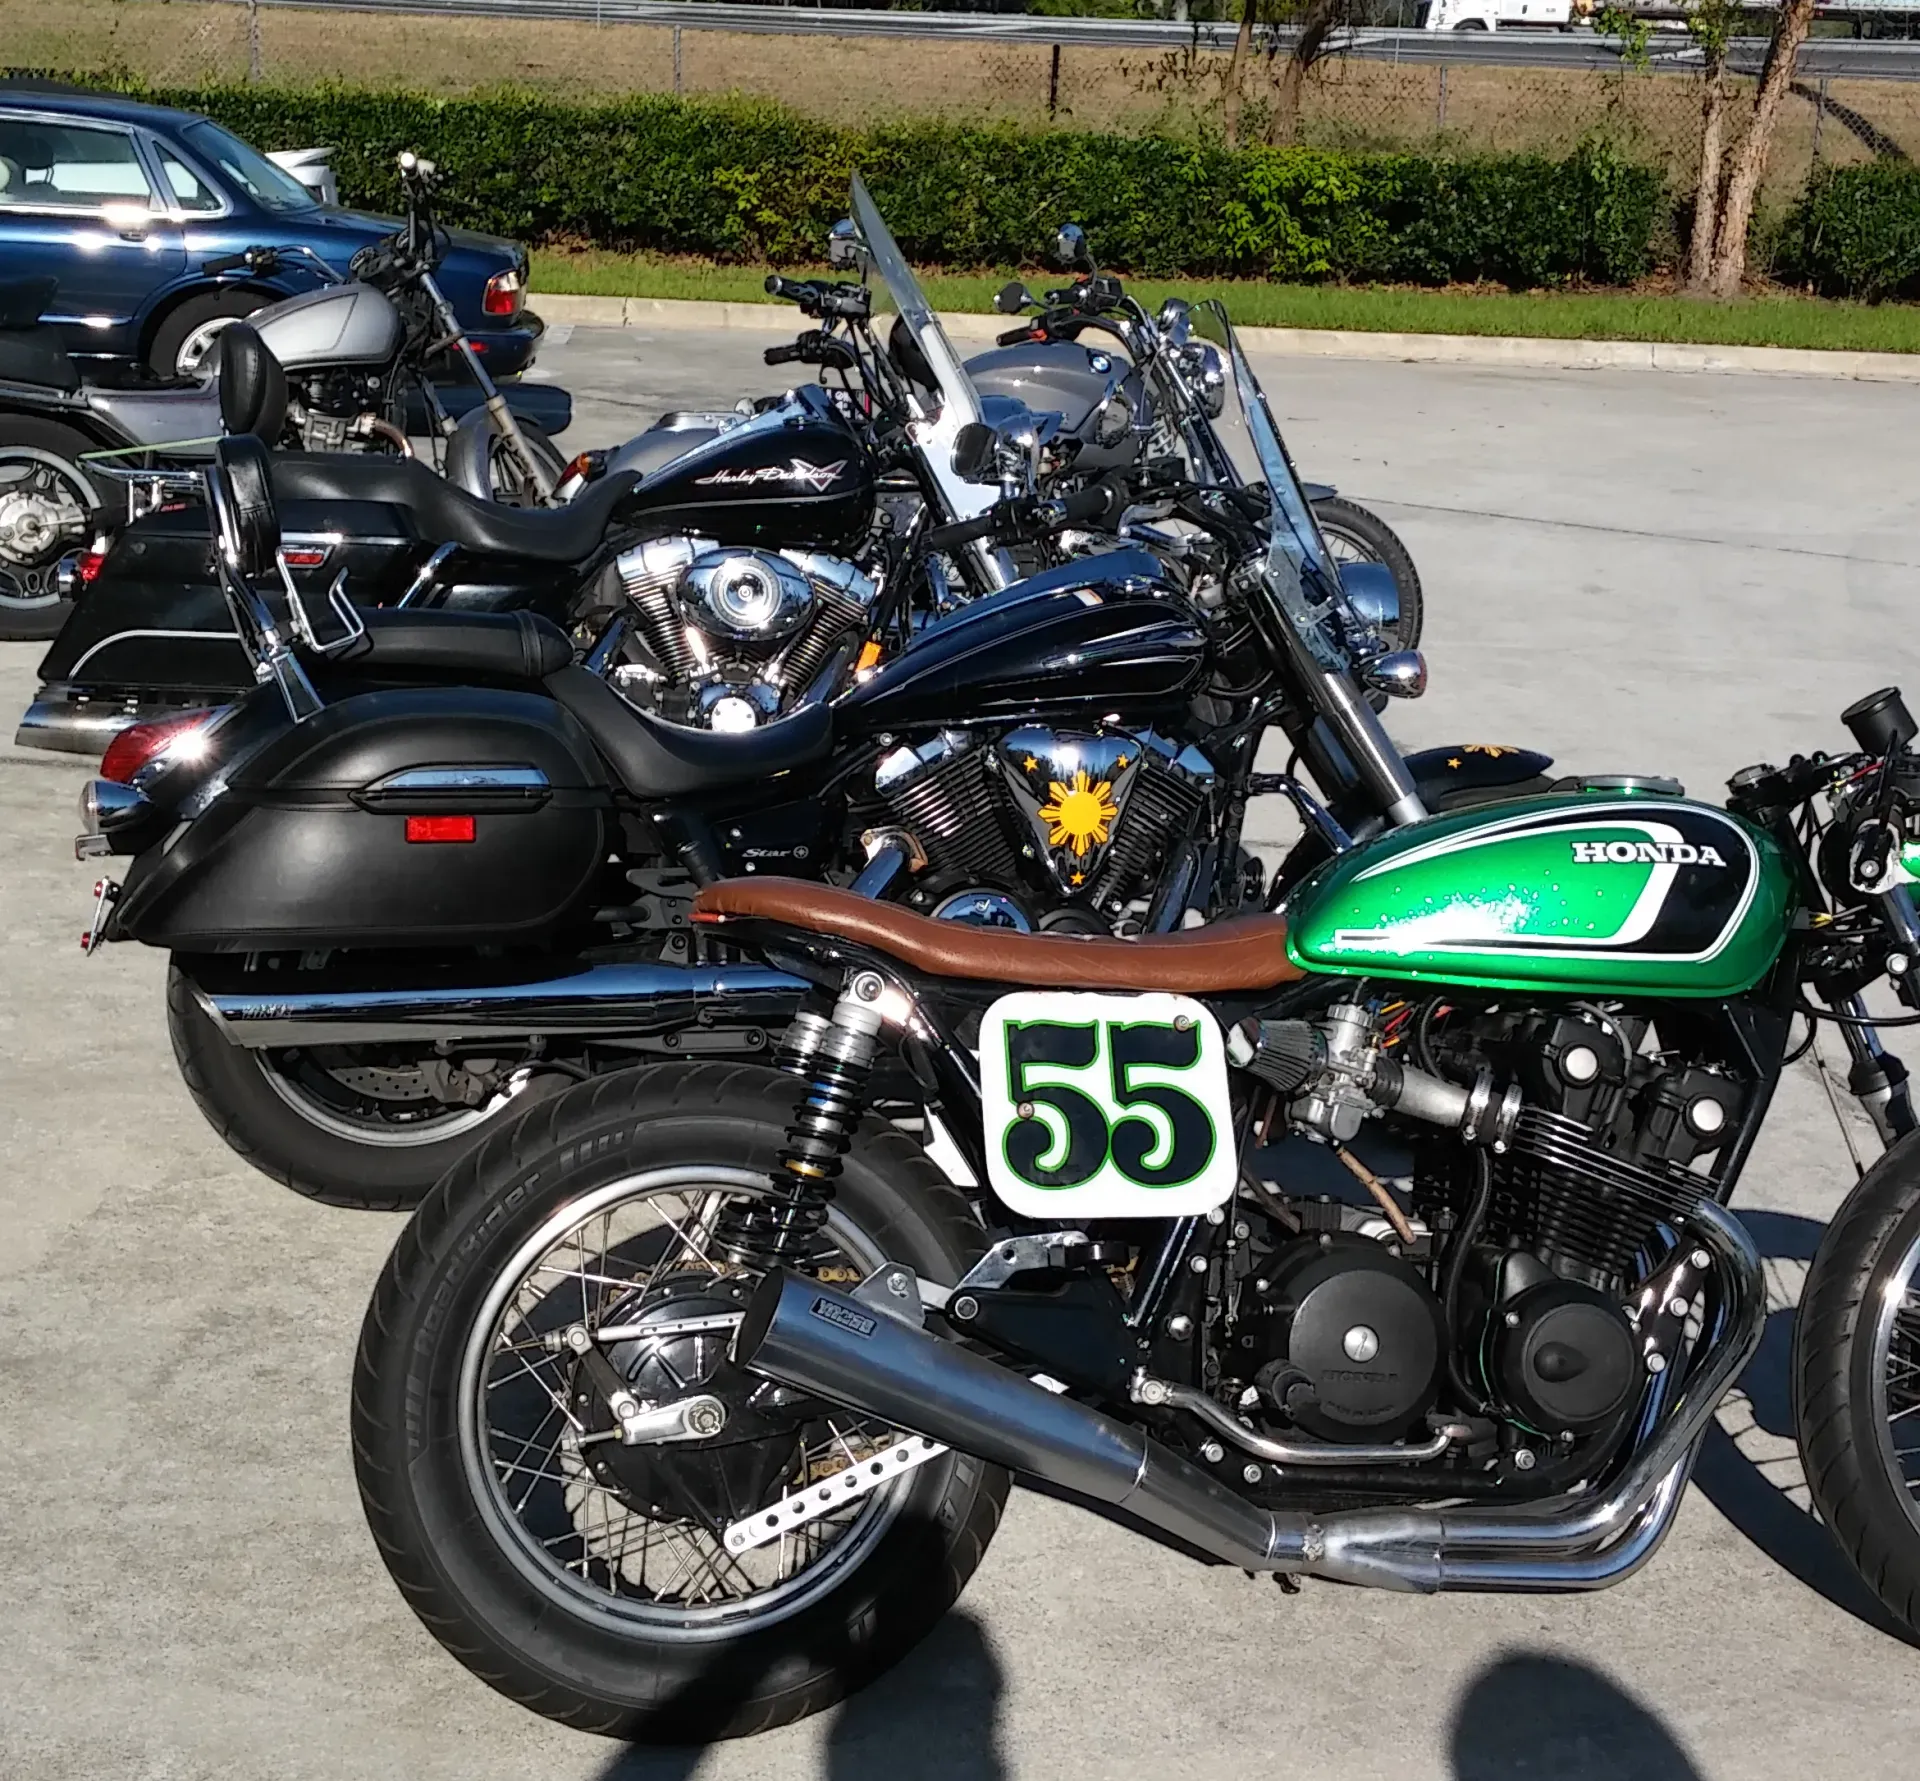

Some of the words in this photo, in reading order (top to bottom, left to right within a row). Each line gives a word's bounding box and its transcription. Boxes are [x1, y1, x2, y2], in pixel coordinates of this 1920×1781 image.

[742, 848, 791, 858] Star
[1572, 841, 1727, 867] HONDA
[1002, 1019, 1217, 1191] 55
